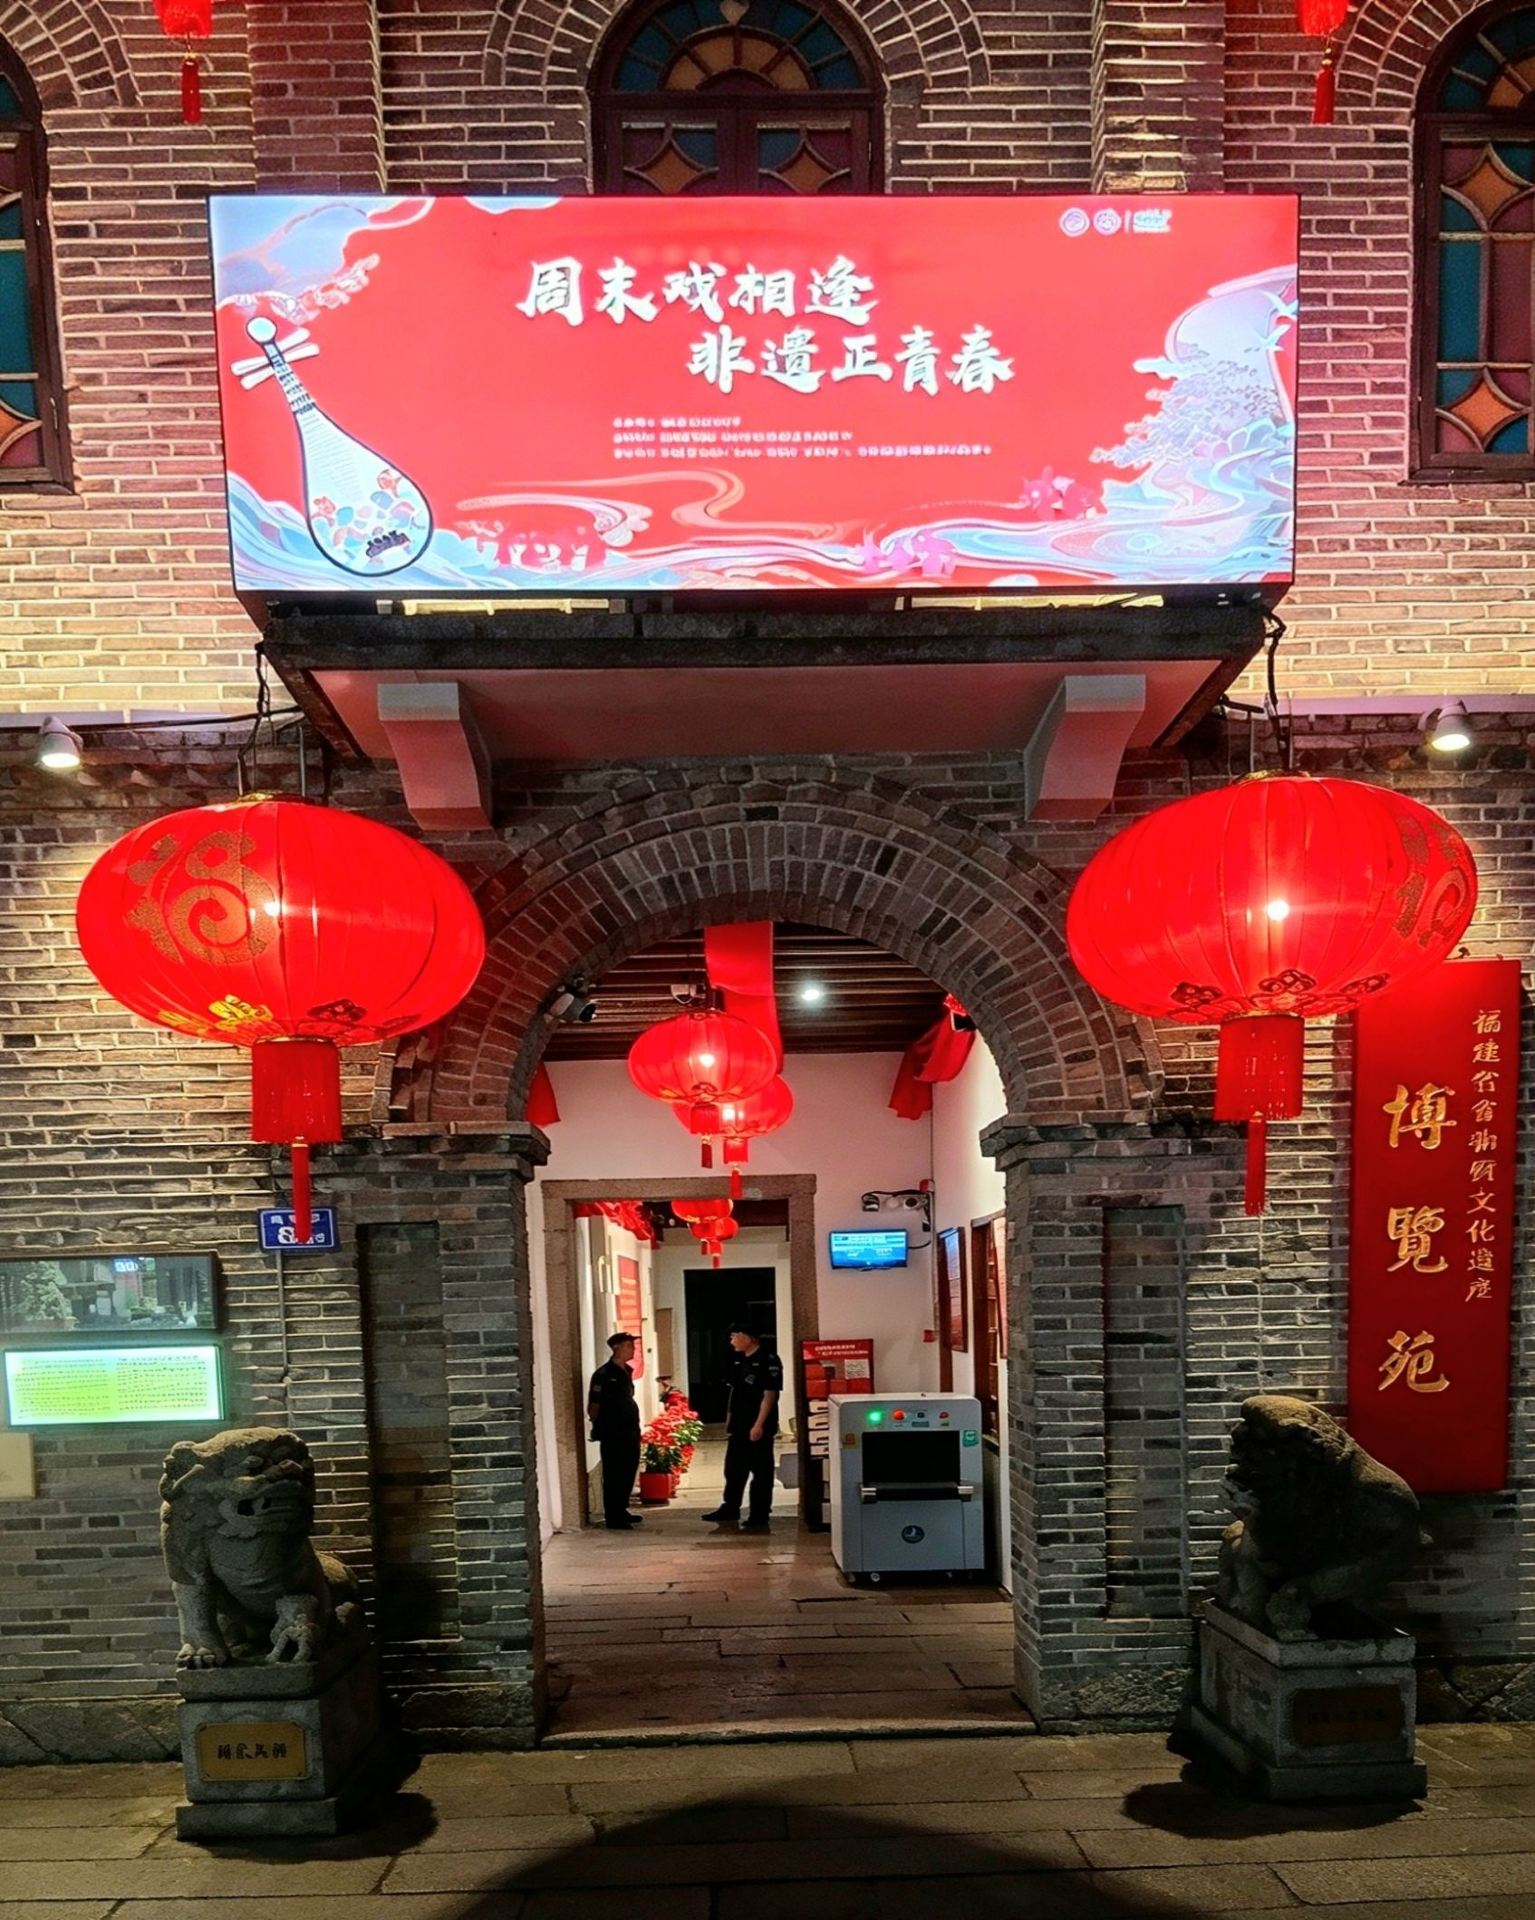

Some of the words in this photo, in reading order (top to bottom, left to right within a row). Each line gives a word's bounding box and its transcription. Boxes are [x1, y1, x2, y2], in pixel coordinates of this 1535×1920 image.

[515, 254, 880, 326] 周末戏相逢
[686, 324, 1015, 396] 非遗正青春
